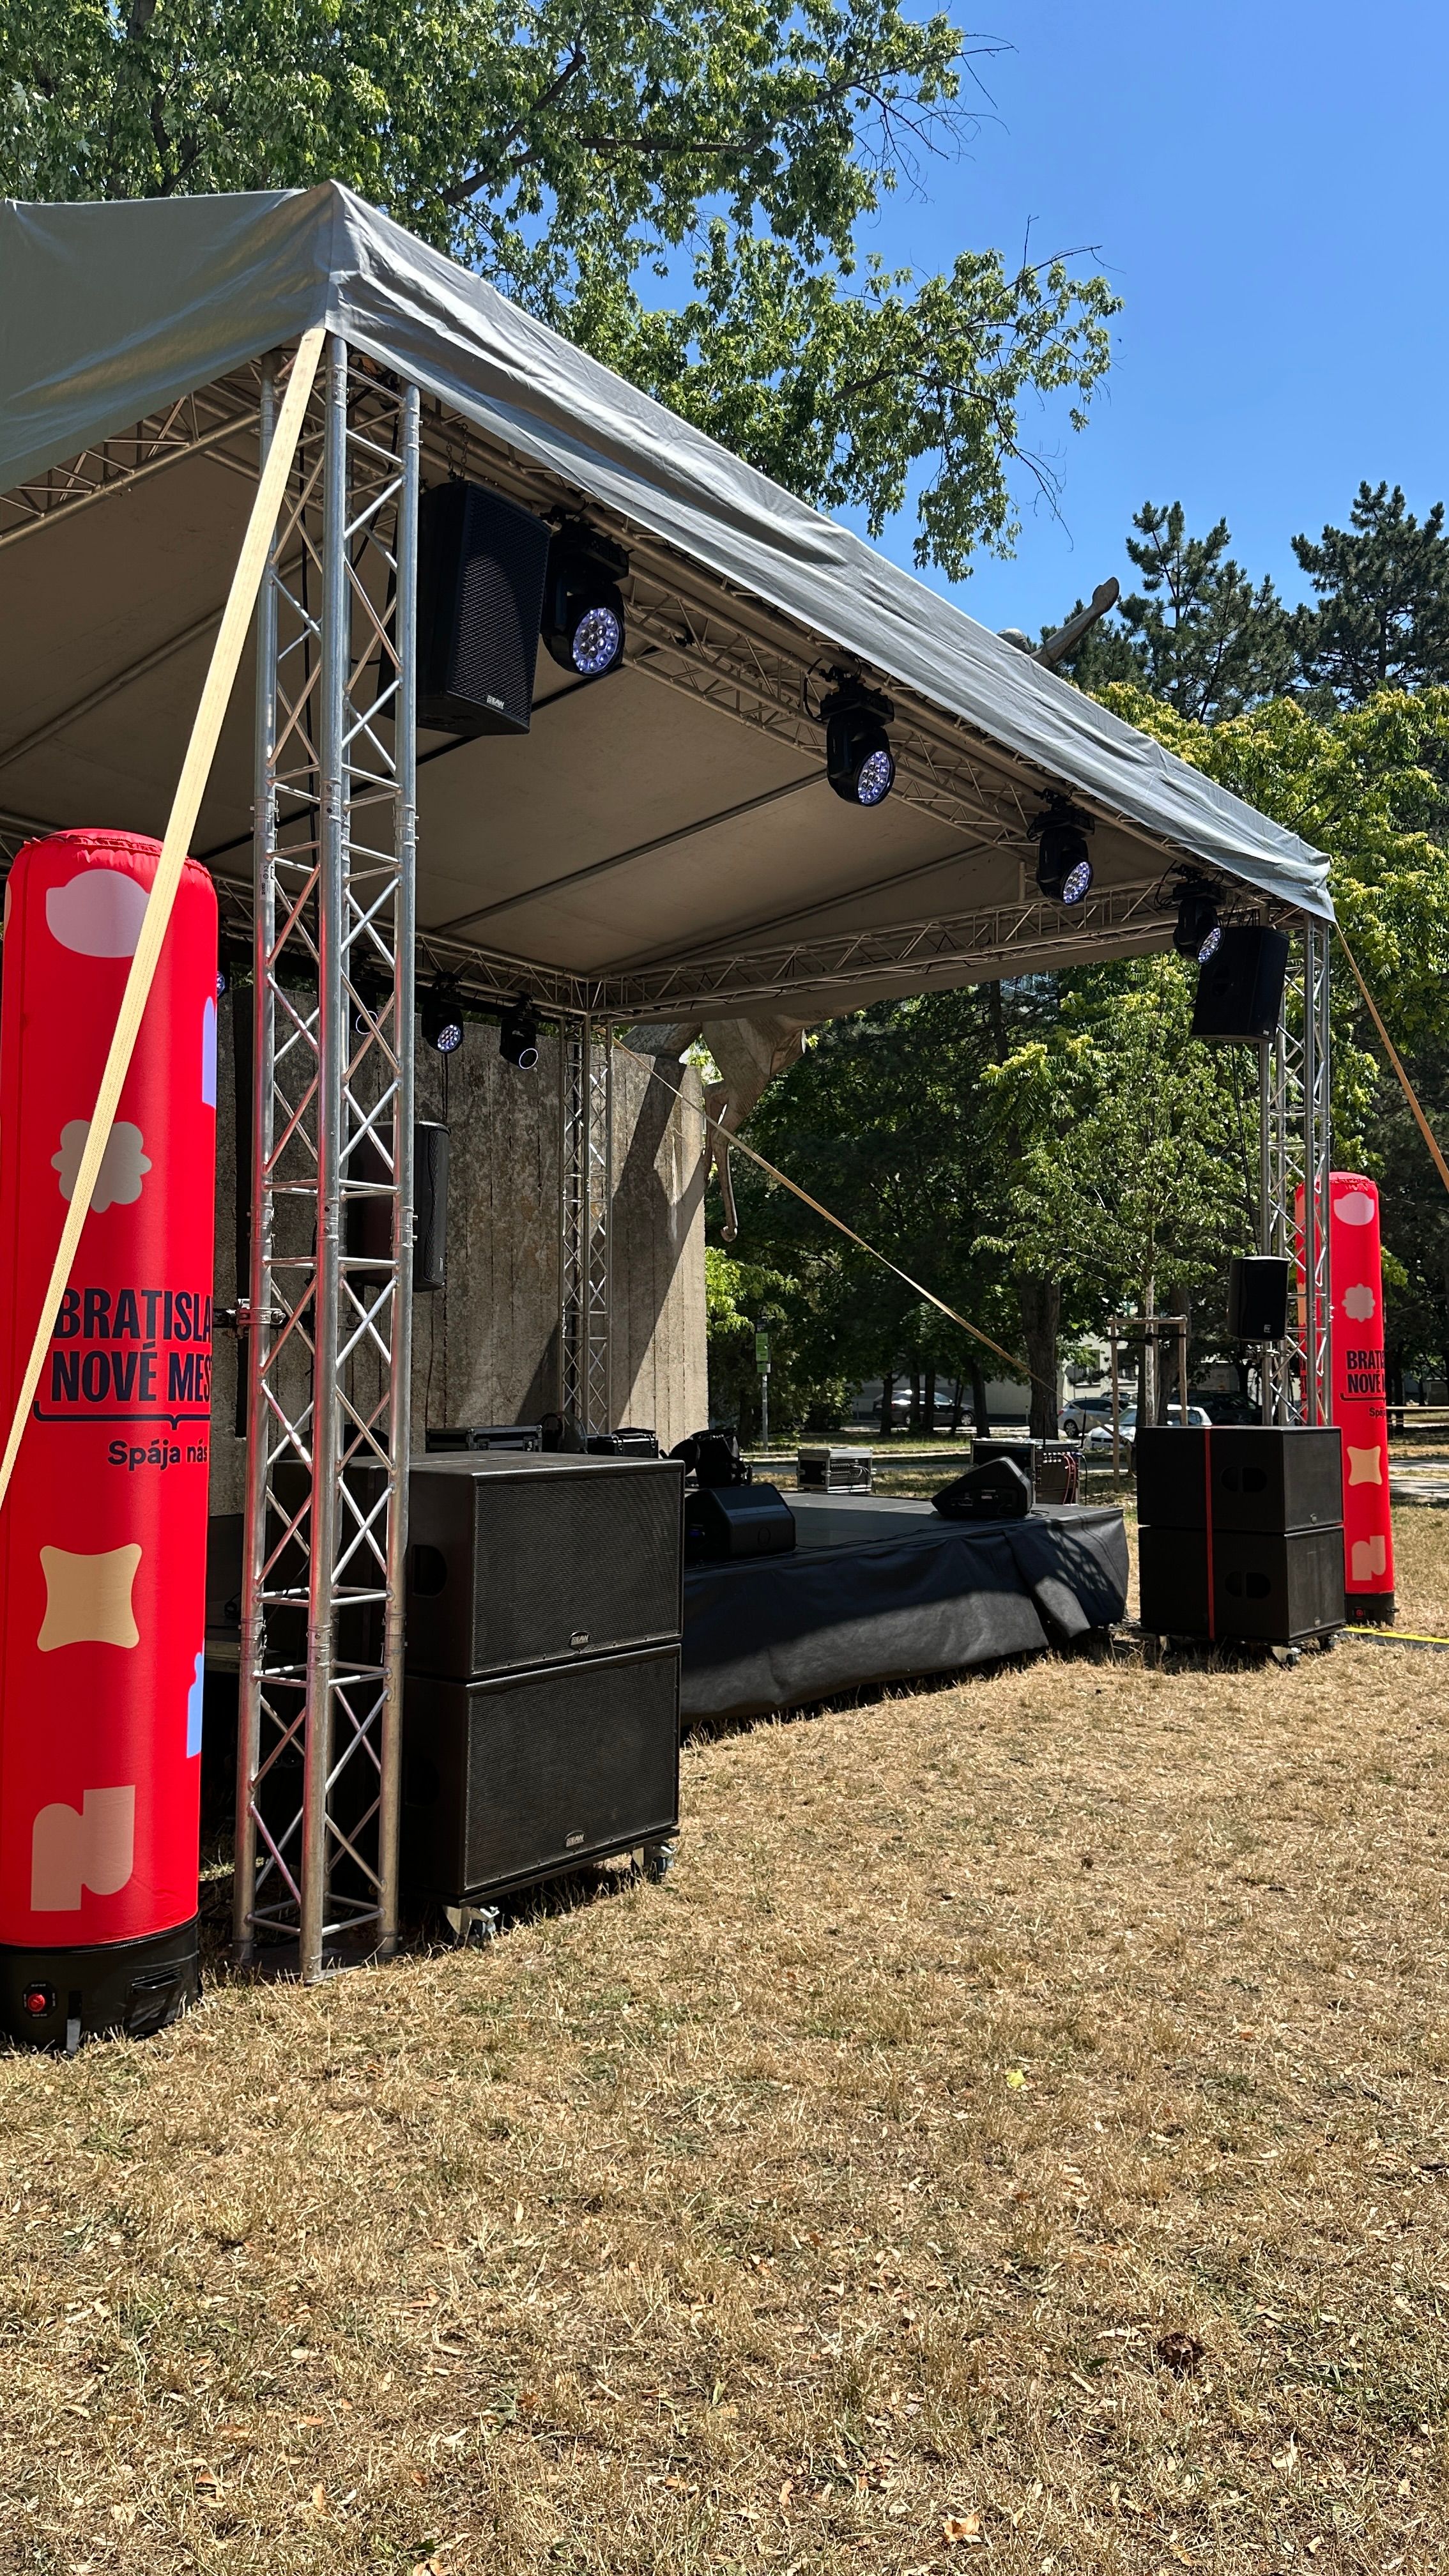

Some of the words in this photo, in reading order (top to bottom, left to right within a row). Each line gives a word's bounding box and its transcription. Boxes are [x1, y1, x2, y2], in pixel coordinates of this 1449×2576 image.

[53, 1288, 213, 1342] BRATISLA
[51, 1341, 157, 1402] NOVÉ
[168, 1352, 213, 1402] MES
[1347, 1369, 1381, 1393] NOVÉ
[107, 1439, 181, 1471] Spája
[187, 1439, 208, 1463] nás
